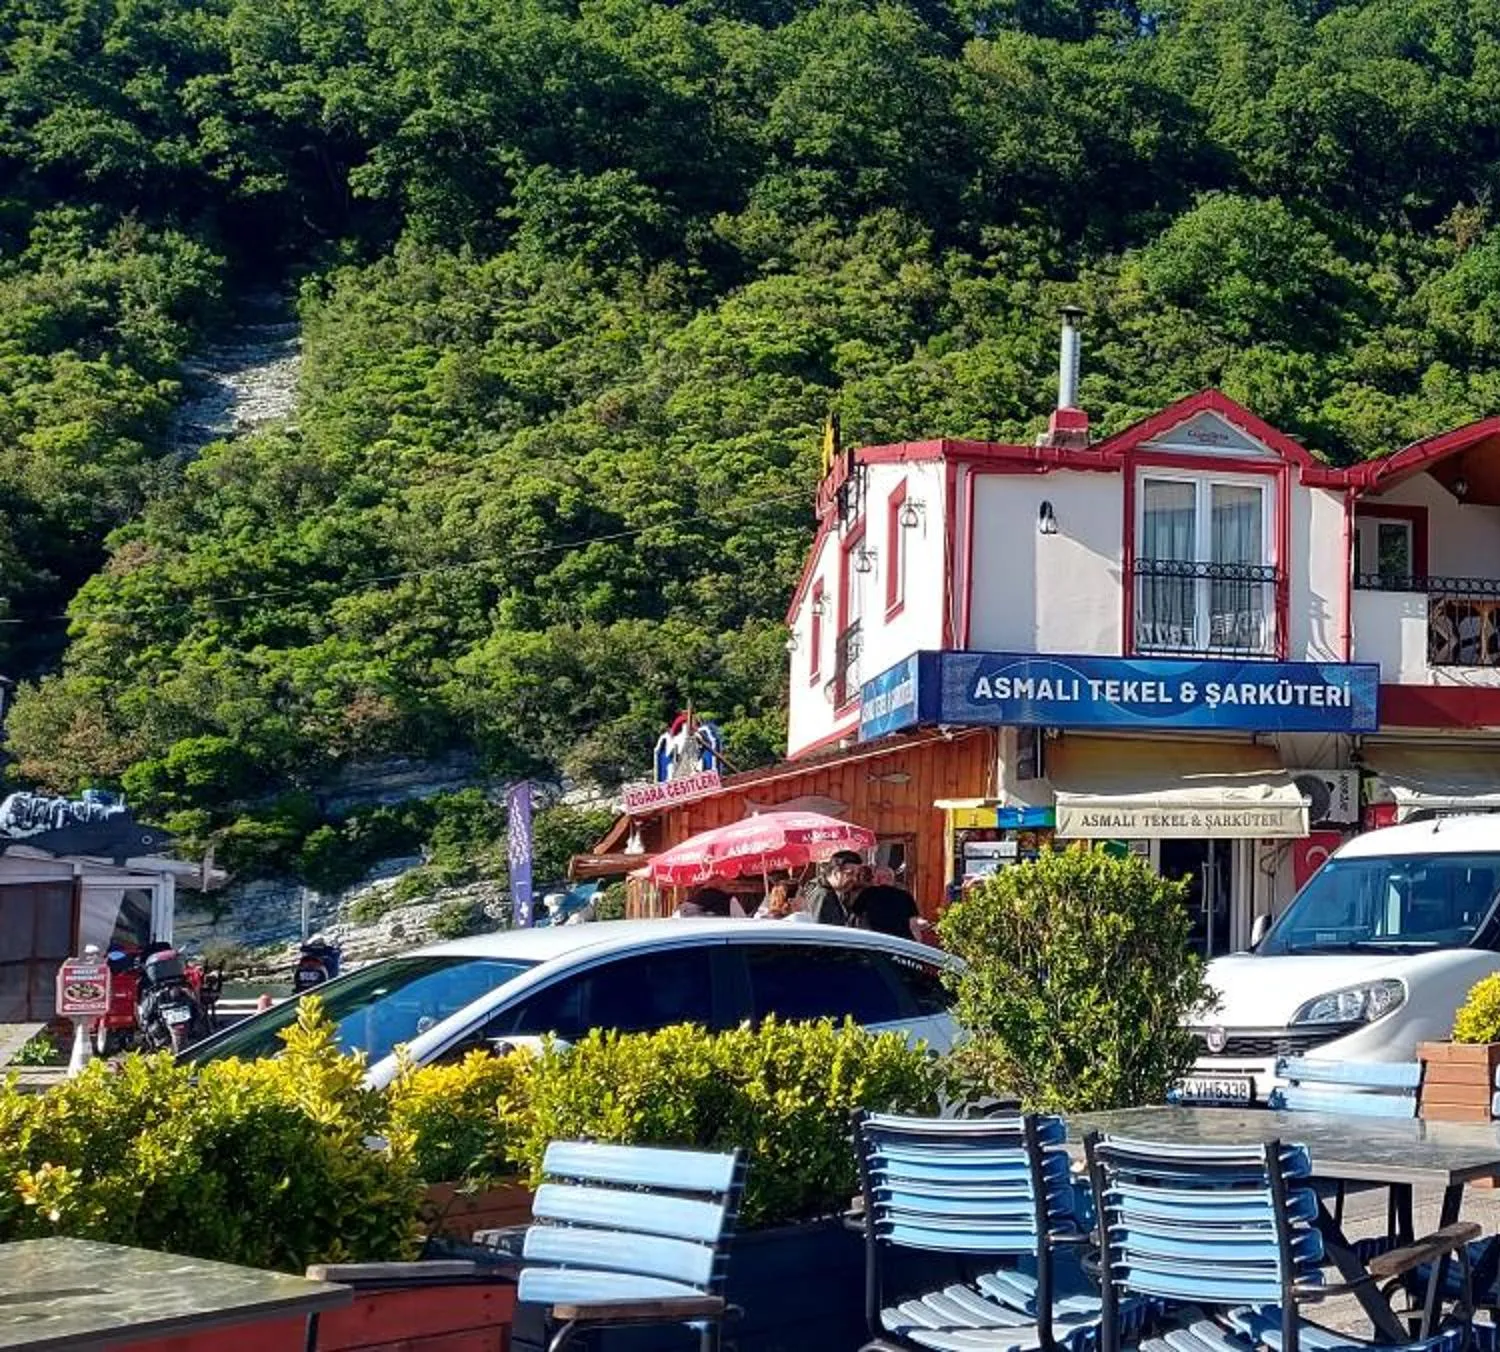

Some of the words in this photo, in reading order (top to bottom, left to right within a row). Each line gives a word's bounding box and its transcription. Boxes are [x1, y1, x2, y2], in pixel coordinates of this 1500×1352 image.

[974, 676, 1079, 701] ASMALI
[1087, 679, 1173, 703] TEKEL
[1179, 682, 1198, 703] &
[1205, 679, 1351, 709] ŞARKÜTERİ
[1081, 814, 1136, 828] ASMALI
[1143, 814, 1190, 828] TEKEL
[1191, 814, 1201, 827] &
[1205, 812, 1284, 830] ŞARKÜTERİ
